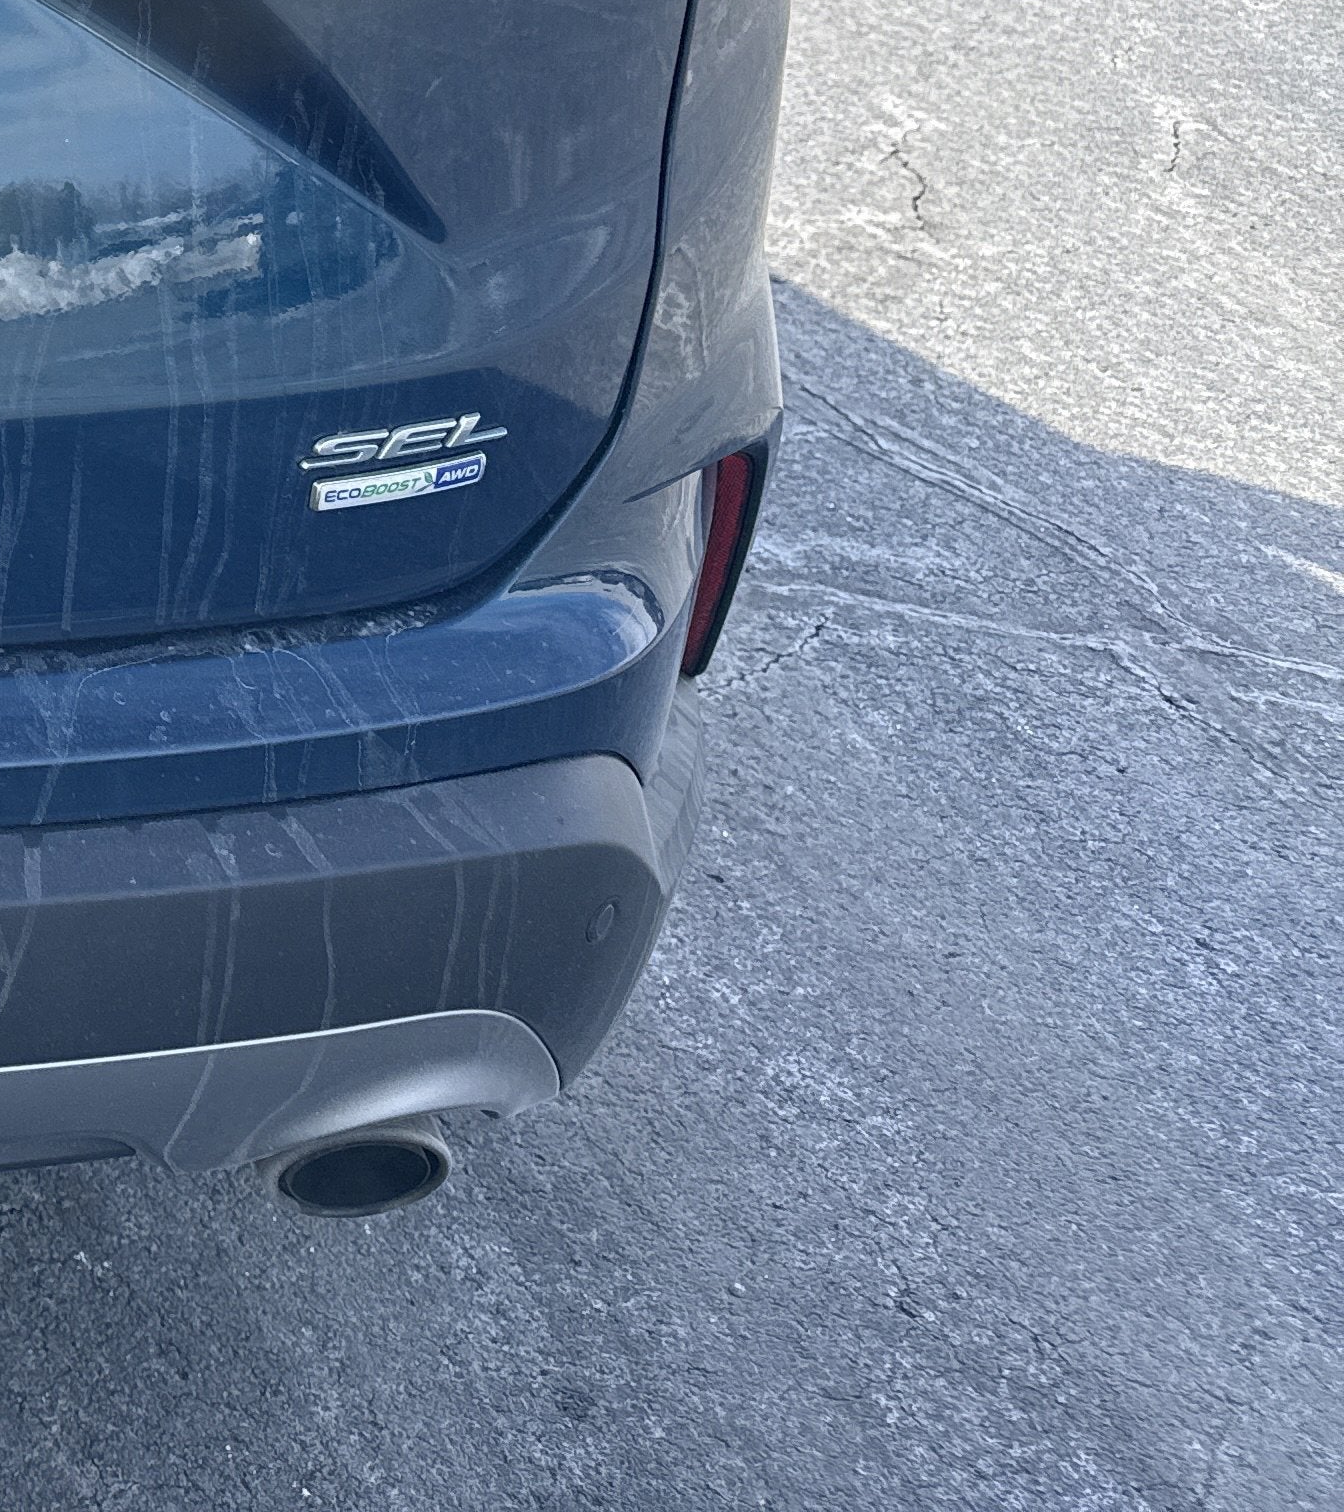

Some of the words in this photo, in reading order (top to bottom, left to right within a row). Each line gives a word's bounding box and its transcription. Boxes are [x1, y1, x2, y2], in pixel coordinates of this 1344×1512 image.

[299, 412, 508, 470] SEL
[324, 477, 422, 503] ECOBOOST
[438, 465, 479, 485] AWD
